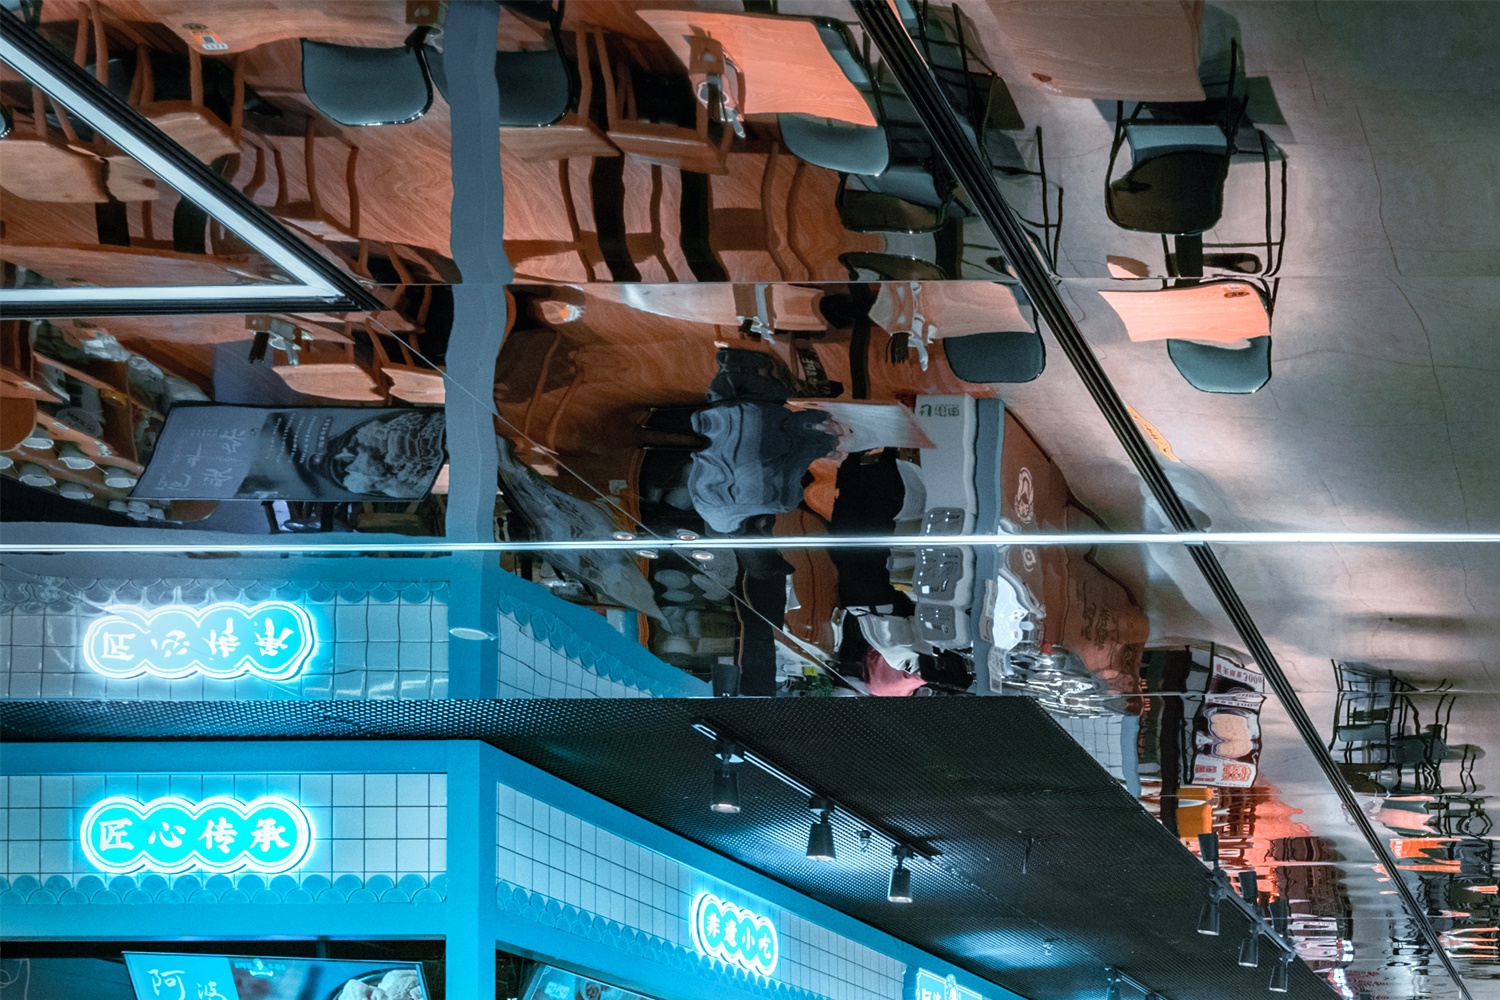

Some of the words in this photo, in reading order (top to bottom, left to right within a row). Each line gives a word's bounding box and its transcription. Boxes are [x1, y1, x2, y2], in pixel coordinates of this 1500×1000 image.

[98, 815, 291, 854] 匠心传承
[706, 911, 773, 961] 非遗小吃
